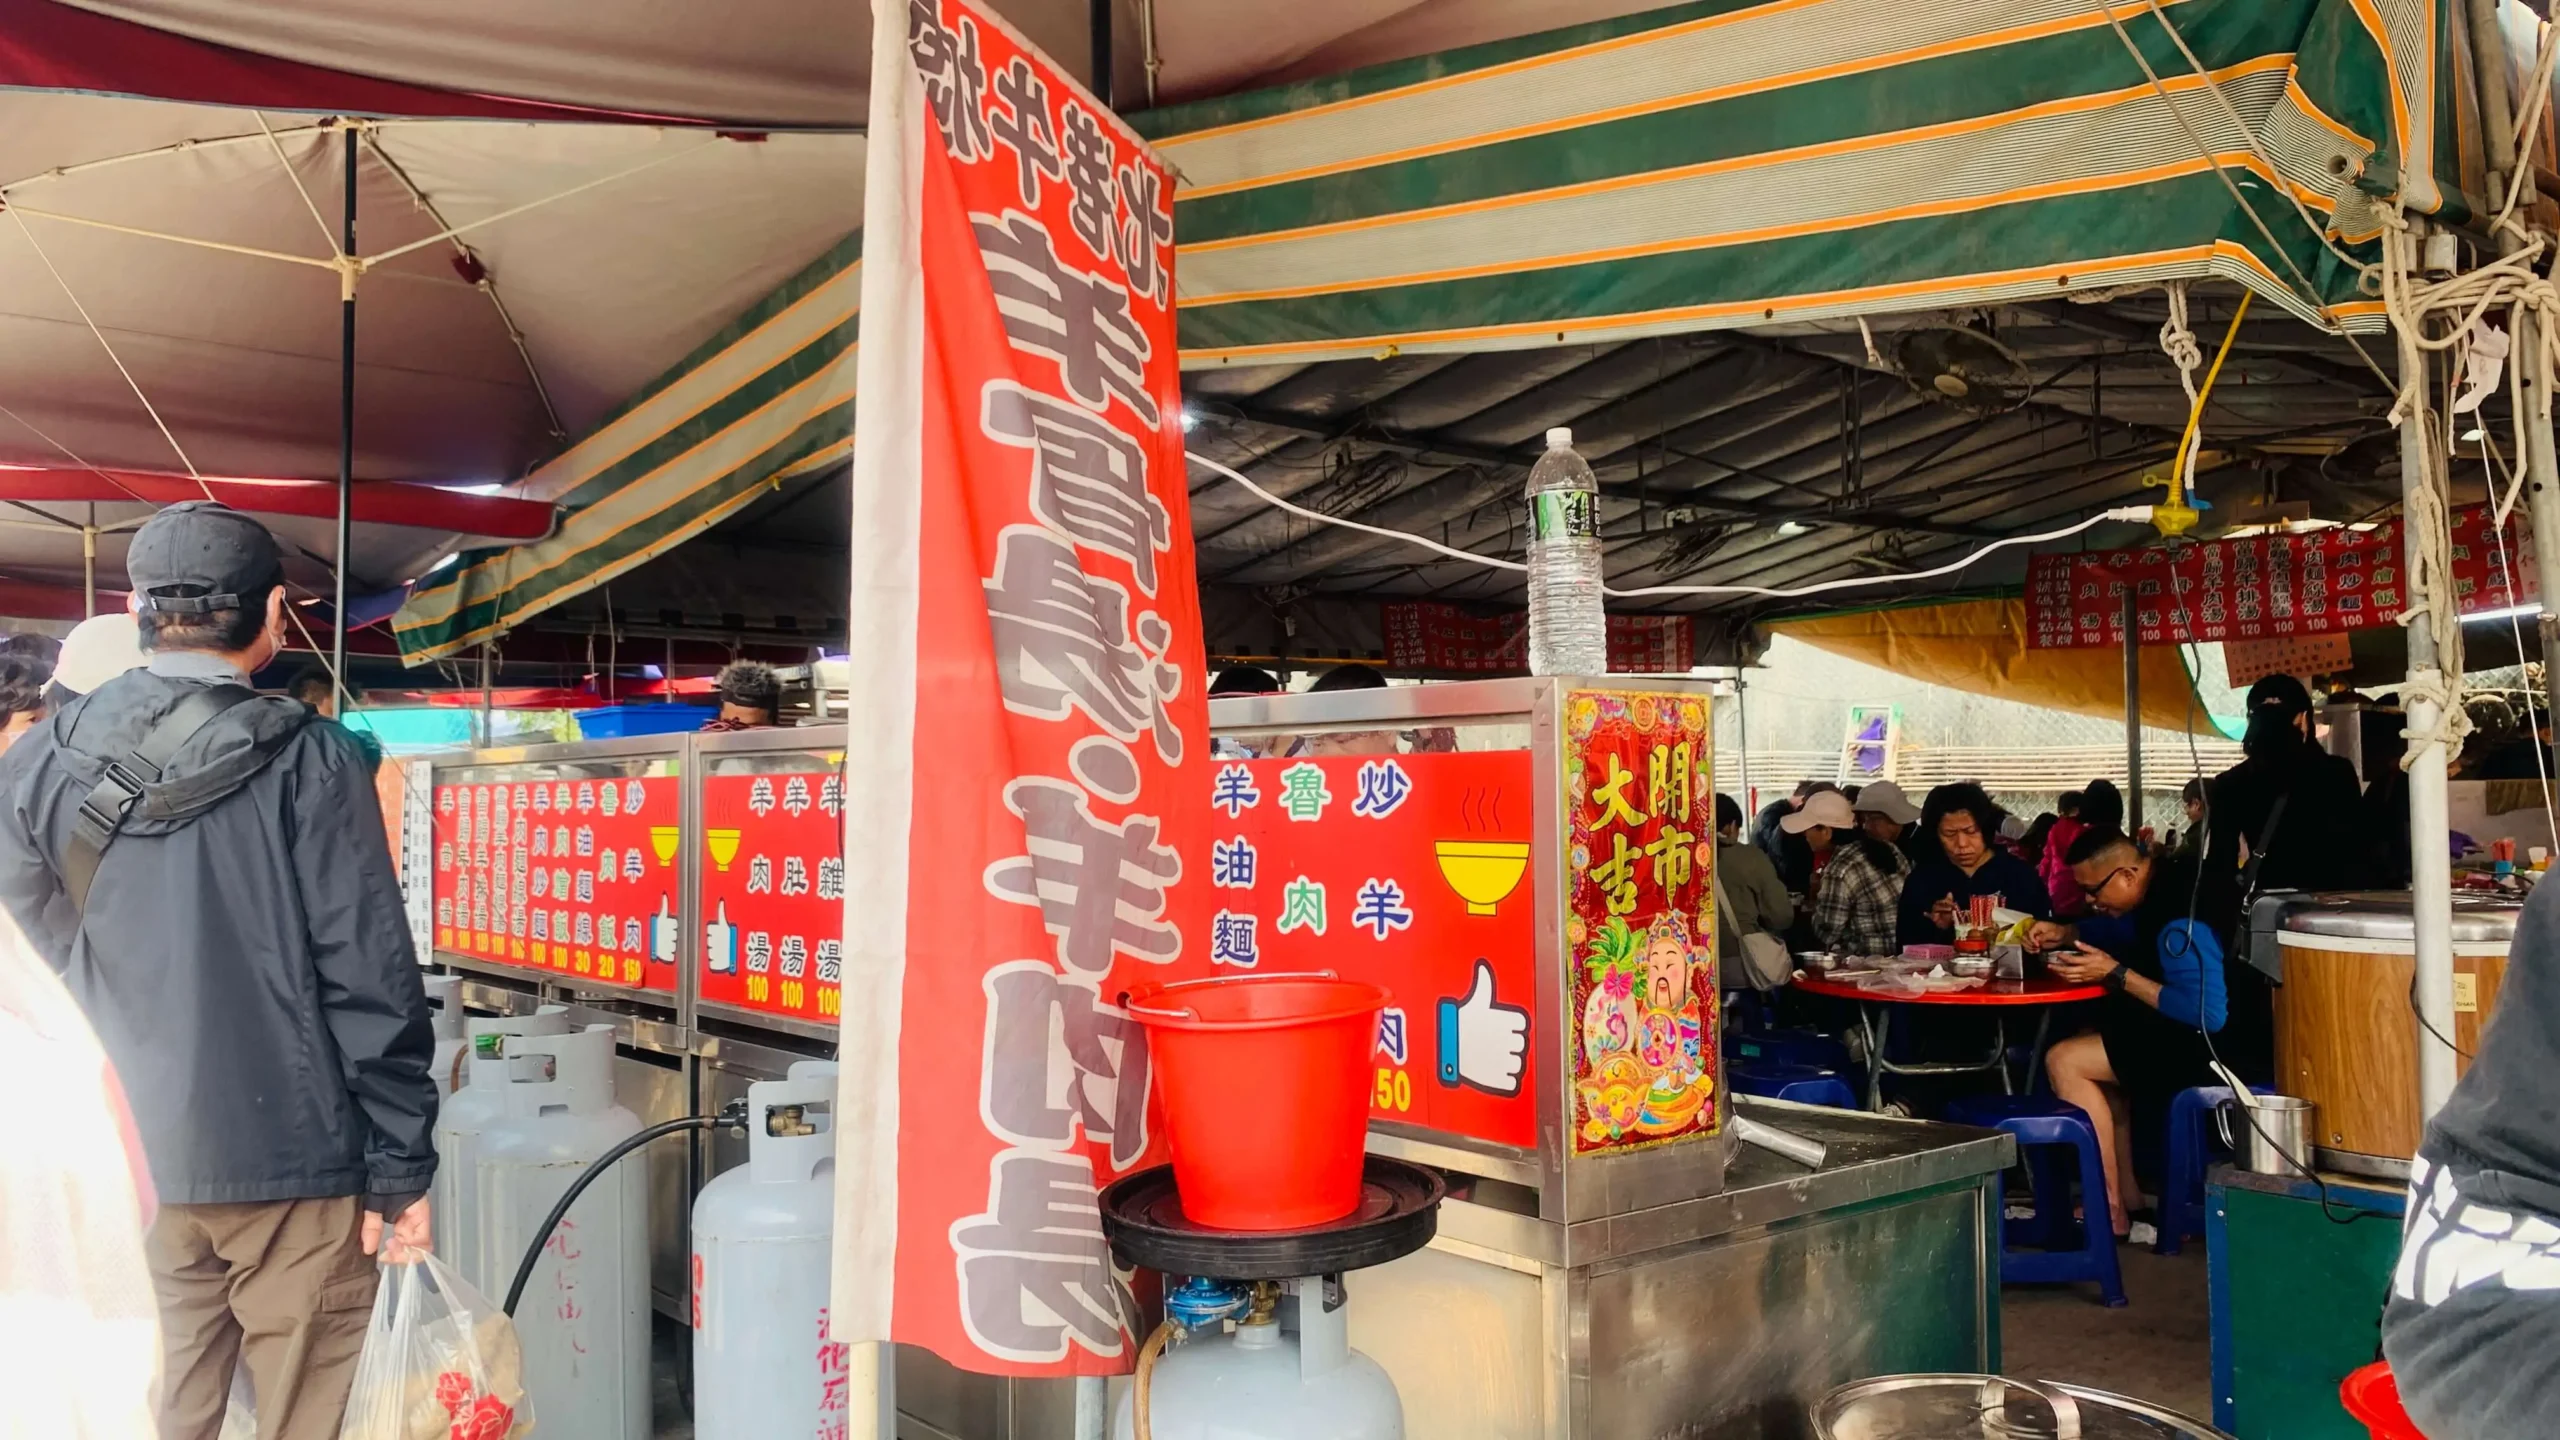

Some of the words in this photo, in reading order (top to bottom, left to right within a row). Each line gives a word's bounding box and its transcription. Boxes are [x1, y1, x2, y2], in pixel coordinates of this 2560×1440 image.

[2274, 621, 2294, 632] 100
[2307, 618, 2328, 630] 100
[2341, 615, 2363, 628] 100
[2378, 610, 2400, 623] 100
[2082, 632, 2101, 644] 100
[2111, 631, 2125, 642] 10
[2141, 629, 2160, 641] 100
[2205, 626, 2226, 637] 100
[2240, 624, 2260, 635] 120
[1588, 752, 1649, 918] 大吉
[1644, 740, 1696, 912] 開市
[598, 781, 619, 950] 魯肉飯
[622, 780, 645, 952] 炒羊肉
[747, 777, 776, 972] 羊肉湯
[780, 776, 811, 977] 羊肚湯
[816, 775, 846, 983] 羊雜湯
[553, 946, 568, 969] 100
[575, 950, 590, 973] 30
[598, 954, 614, 978] 20
[623, 958, 641, 982] 150
[747, 974, 768, 1002] 100
[781, 980, 803, 1009] 100
[817, 986, 841, 1016] 100
[1370, 1069, 1411, 1113] 50
